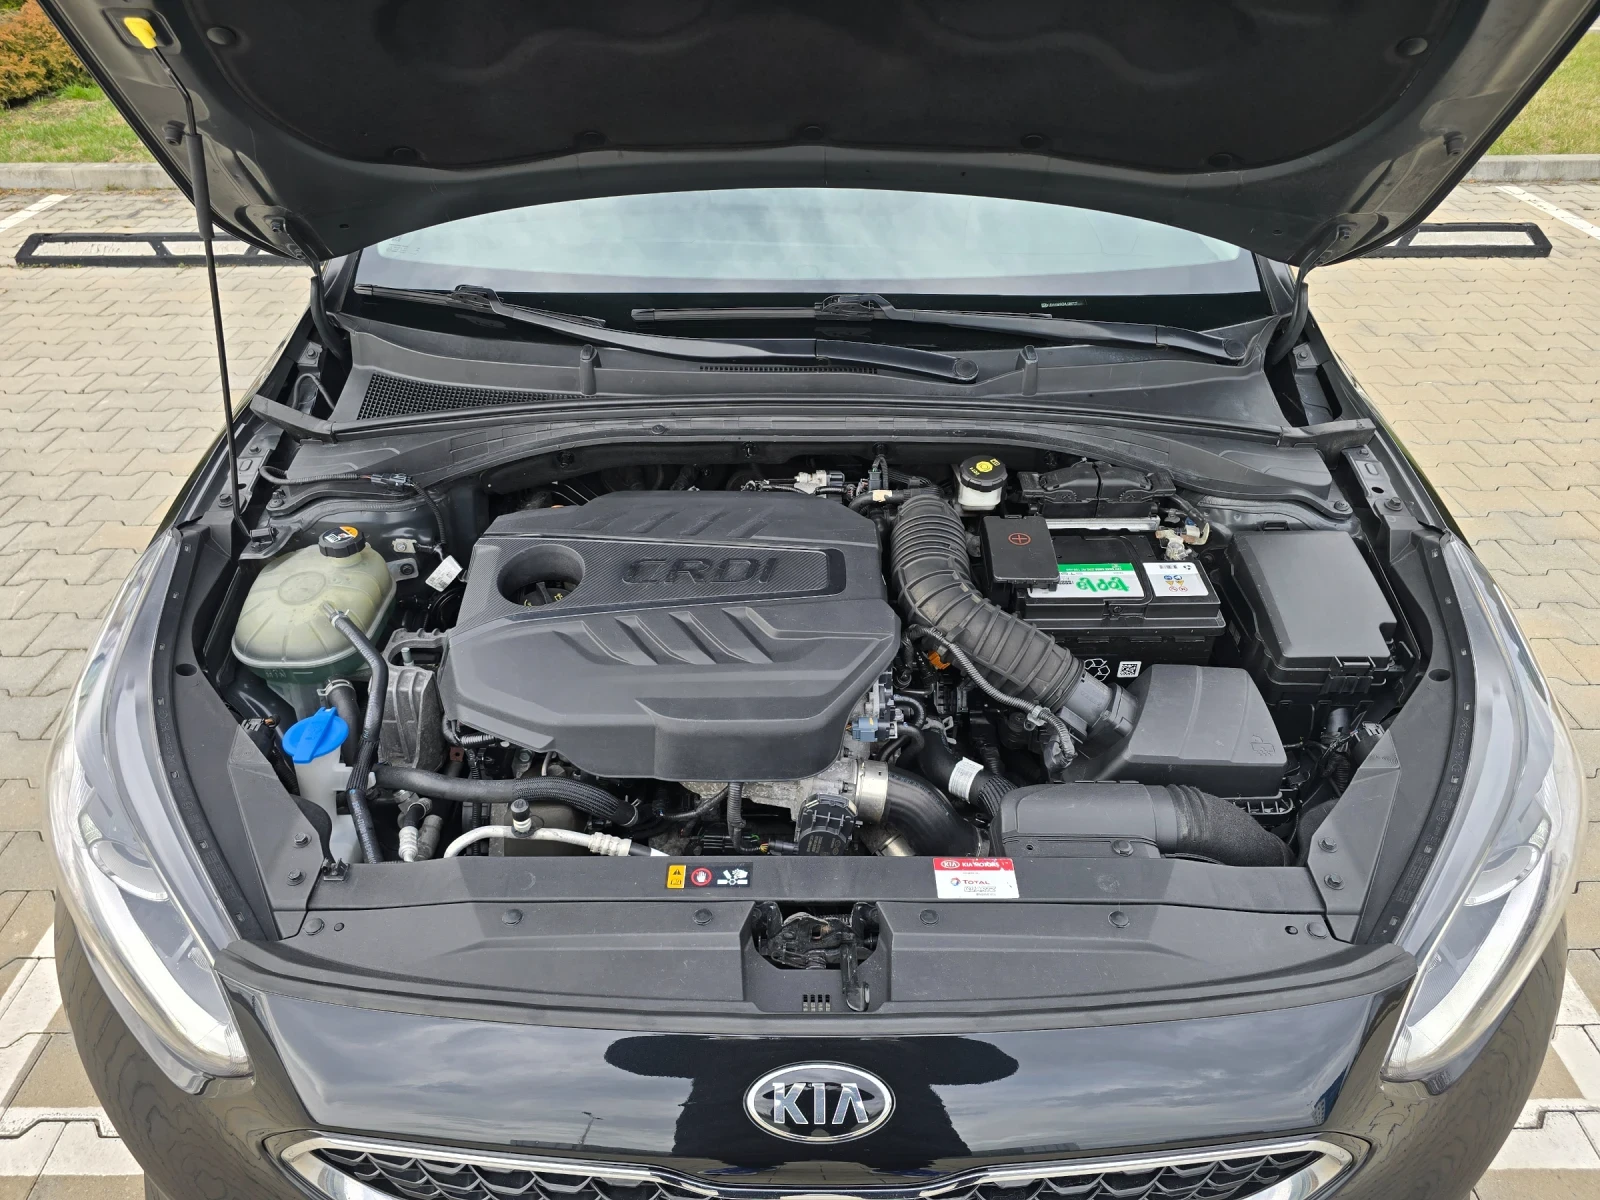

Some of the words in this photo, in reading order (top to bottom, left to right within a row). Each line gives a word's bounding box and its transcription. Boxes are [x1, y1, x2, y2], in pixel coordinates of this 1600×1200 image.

[622, 557, 777, 584] CRDI
[1076, 576, 1130, 592] topla
[772, 1082, 870, 1125] KIA
